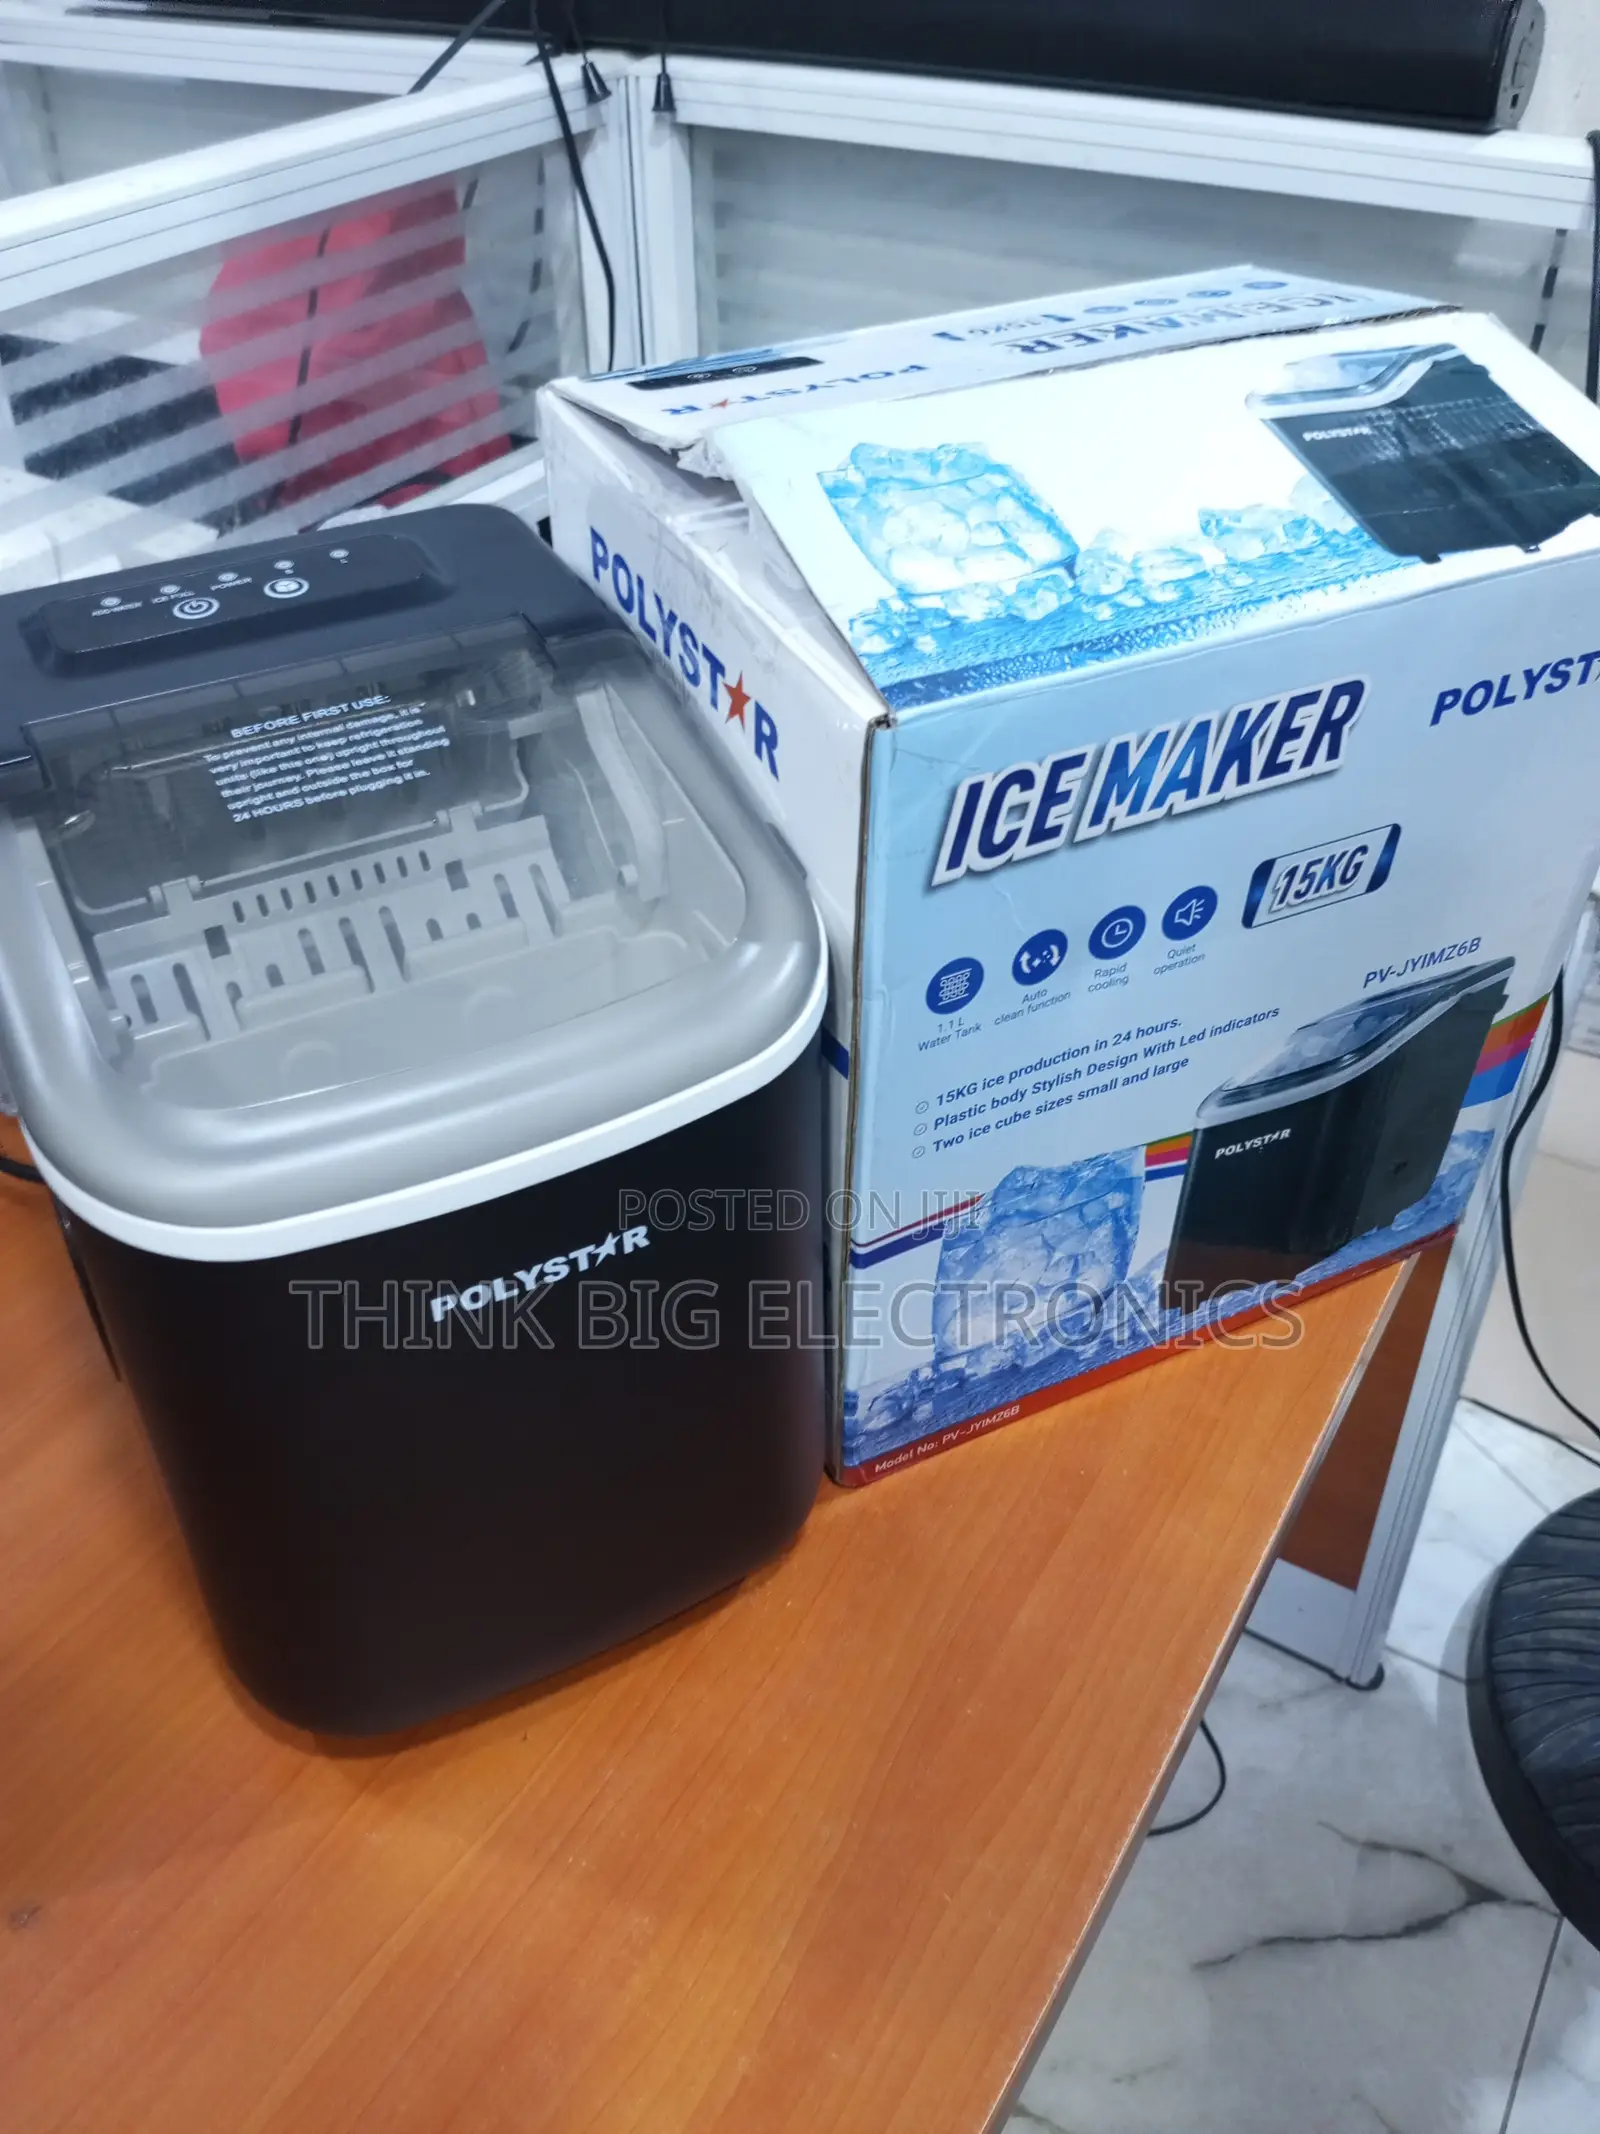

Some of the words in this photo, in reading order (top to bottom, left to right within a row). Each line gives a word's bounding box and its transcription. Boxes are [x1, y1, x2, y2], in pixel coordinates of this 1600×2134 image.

[1429, 650, 1600, 727] POLYST
[230, 714, 301, 738] BEFORE
[301, 703, 349, 721] FIRST
[379, 725, 446, 747] throughout
[222, 741, 272, 760] prevent
[296, 724, 345, 741] internal
[239, 747, 302, 767] important
[348, 719, 424, 742] refrigeration
[938, 748, 1091, 879] ICE
[1082, 676, 1370, 835] MAKER
[232, 811, 252, 822] 24
[251, 798, 305, 817] HOURS
[303, 789, 348, 804] before
[1272, 844, 1369, 909] 15KG
[1153, 953, 1206, 976] operation
[1166, 944, 1197, 960] Quiet
[1362, 936, 1482, 989] PV-JYIMZ6B
[1087, 975, 1130, 993] cooling
[1094, 962, 1128, 979] Rapid
[993, 1008, 1025, 1026] clean
[1026, 990, 1072, 1016] function
[1021, 988, 1049, 1005] Auto
[917, 1033, 952, 1052] Water
[954, 1022, 982, 1041] Tank
[933, 1103, 987, 1131] Plastic
[990, 1087, 1028, 1111] body
[1031, 1067, 1082, 1095] Stylish
[1086, 1051, 1138, 1076] Design
[1143, 1038, 1176, 1059] With
[1179, 1028, 1207, 1048] Led
[1209, 1007, 1280, 1038] indicators
[936, 1082, 978, 1106] 15KG
[981, 1074, 1005, 1091] ice
[1008, 1045, 1090, 1084] production
[1093, 1039, 1108, 1052] in
[1112, 1030, 1133, 1047] 24
[1135, 1017, 1183, 1040] hours.
[932, 1134, 965, 1153] Two
[968, 1123, 991, 1140] ice
[994, 1107, 1031, 1130] cube
[1035, 1093, 1074, 1116] sizes
[1077, 1077, 1118, 1101] small
[1121, 1068, 1149, 1088] and
[1152, 1057, 1190, 1078] large
[874, 1448, 914, 1473] Model
[916, 1442, 939, 1455] No:
